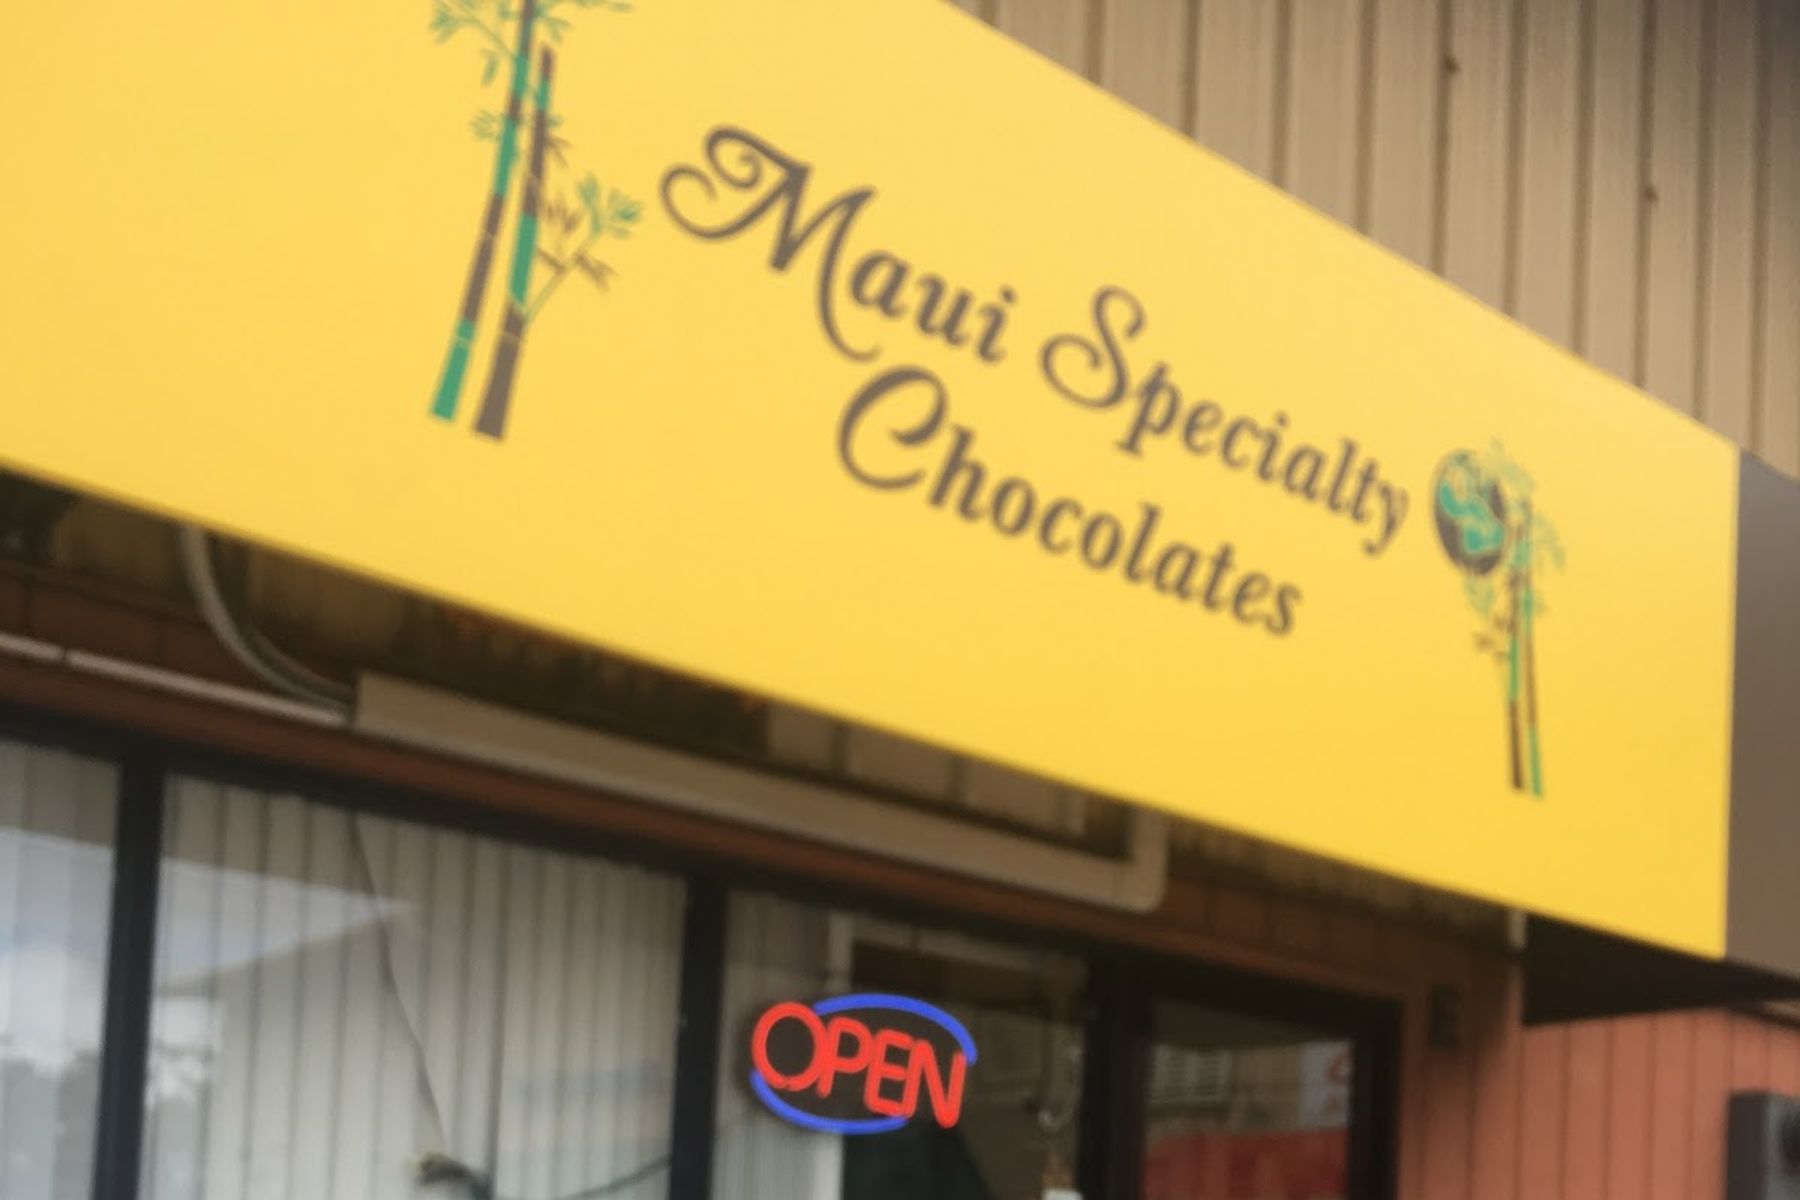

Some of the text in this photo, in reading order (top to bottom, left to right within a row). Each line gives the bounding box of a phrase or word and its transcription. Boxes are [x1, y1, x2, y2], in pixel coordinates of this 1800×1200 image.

[660, 125, 1409, 556] Maui Specialty
[837, 366, 1303, 636] Chocolates
[752, 1002, 967, 1128] OPEN
